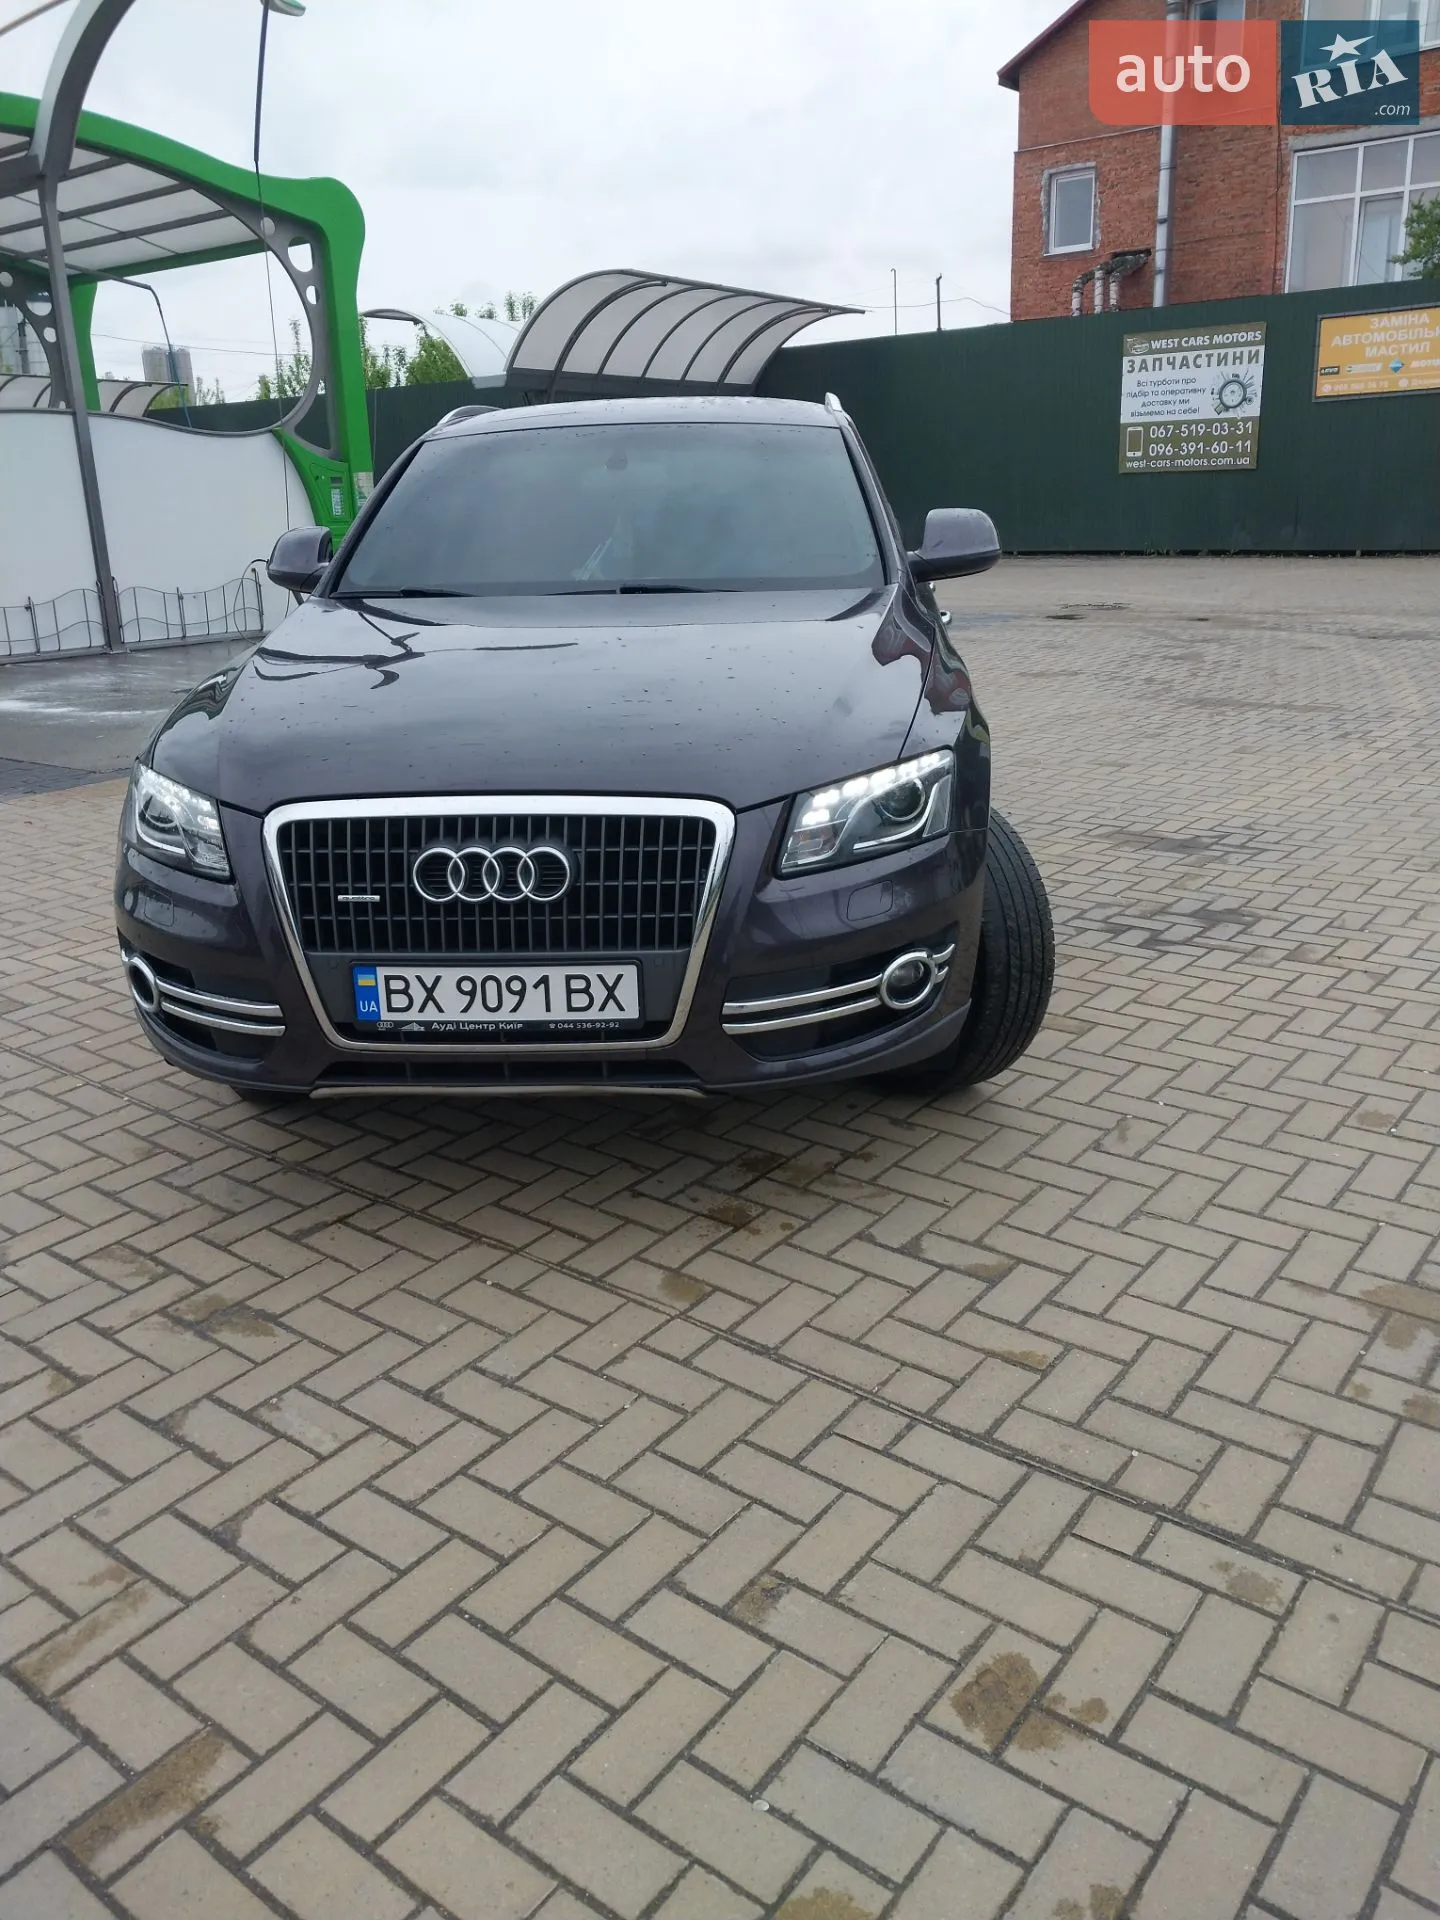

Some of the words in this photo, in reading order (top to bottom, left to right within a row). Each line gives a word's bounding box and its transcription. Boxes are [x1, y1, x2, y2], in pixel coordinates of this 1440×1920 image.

[1370, 312, 1430, 329] ЗАМІНА
[1151, 338, 1180, 350] WEST
[1181, 335, 1210, 347] CARS
[1212, 330, 1262, 345] MOTORS
[1365, 340, 1431, 358] МАСТИЛ
[1127, 349, 1260, 374] ЗАПЧАСТИНИ
[1136, 380, 1148, 388] Всі
[1181, 377, 1197, 385] про
[1126, 390, 1150, 399] підбір
[1160, 387, 1207, 397] оперативну
[1141, 399, 1177, 408] доставку
[1149, 420, 1253, 438] 067-519-03-31
[1149, 440, 1252, 457] 096-391-60-11
[1126, 456, 1250, 468] west-cars-motors.com.ua
[383, 974, 445, 1013] BX
[455, 974, 552, 1013] 9091
[565, 973, 626, 1013] BX
[359, 1000, 378, 1012] UA
[431, 1022, 457, 1031] Ауді
[460, 1022, 496, 1031] Центр
[576, 1021, 620, 1029] 536-92-92
